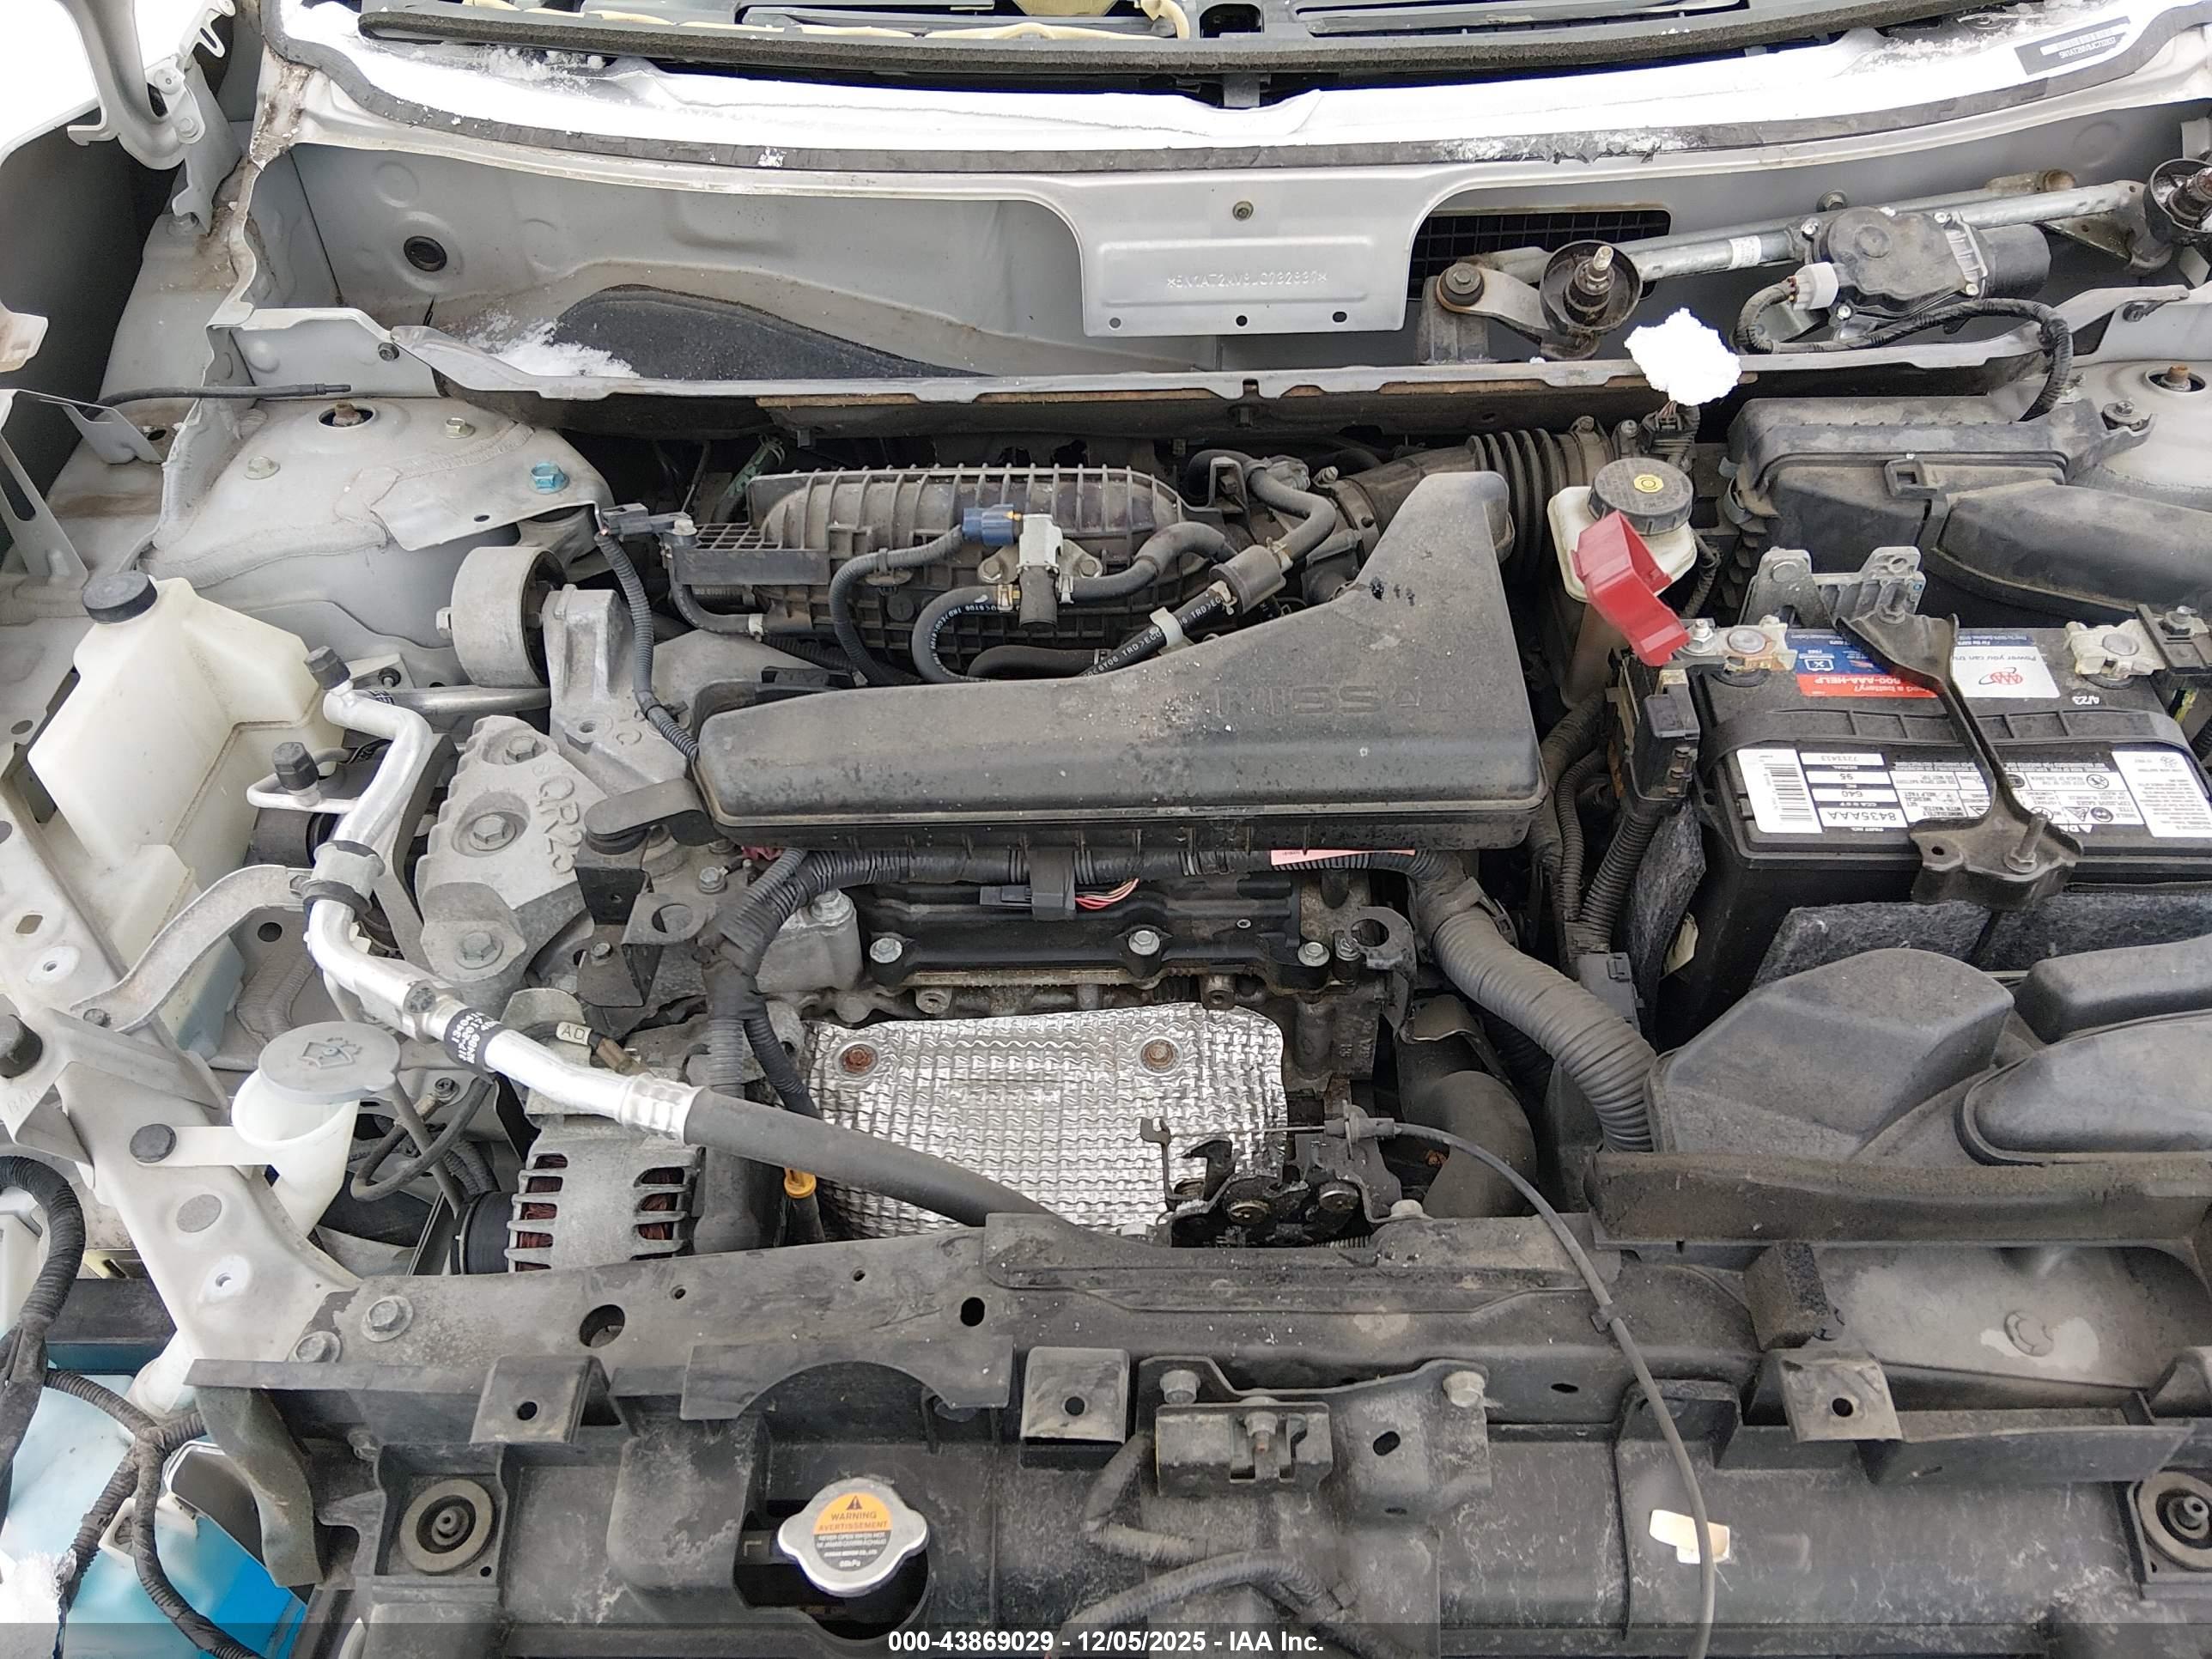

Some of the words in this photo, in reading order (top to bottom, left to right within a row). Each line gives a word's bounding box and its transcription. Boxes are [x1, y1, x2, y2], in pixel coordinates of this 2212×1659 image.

[1991, 672, 2022, 684] AAA
[1827, 811, 1897, 821] 8435AAA
[536, 775, 584, 874] QR25
[830, 1510, 878, 1521] WARNING
[818, 1520, 888, 1532] AVERTISSEMENT
